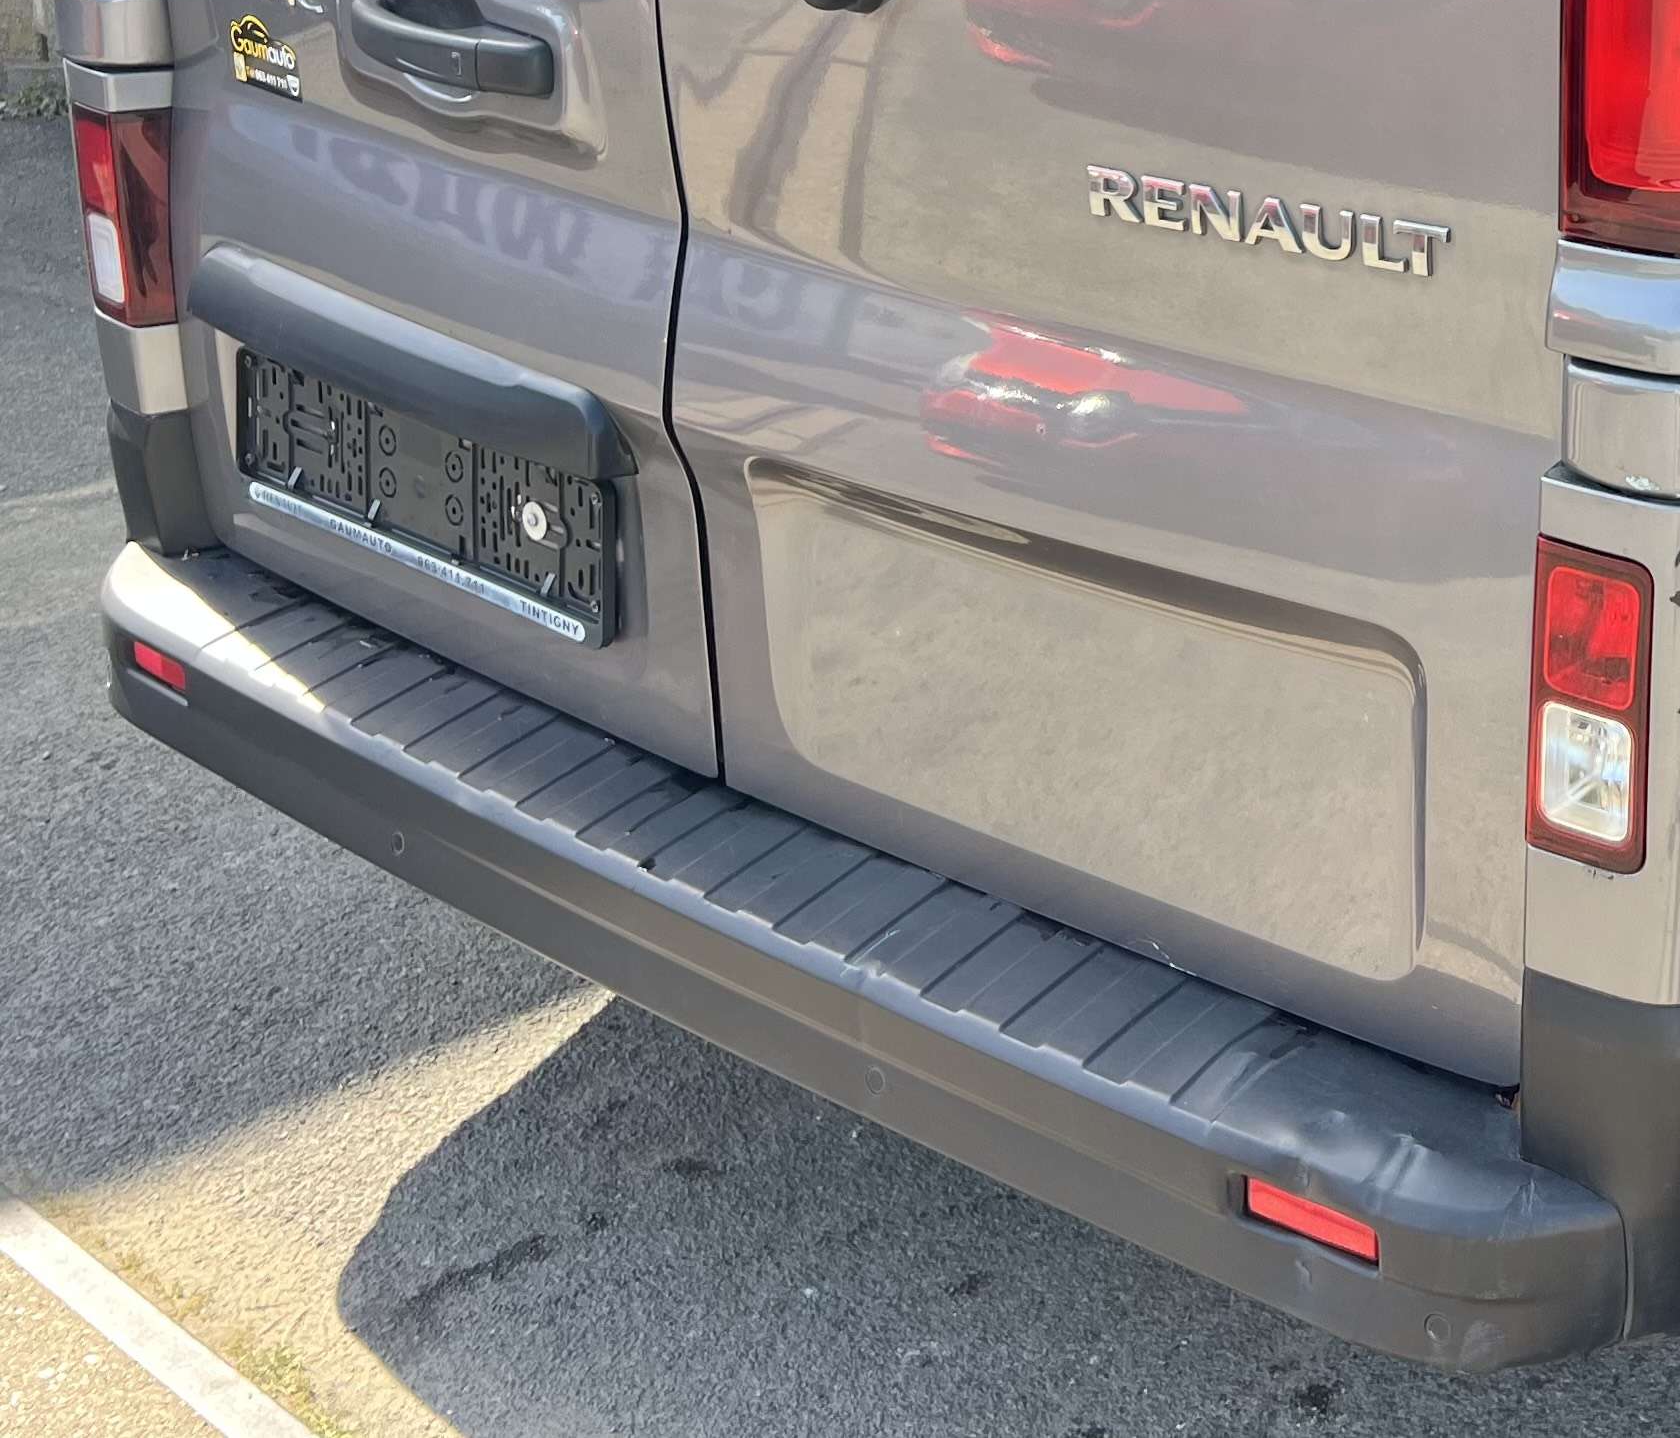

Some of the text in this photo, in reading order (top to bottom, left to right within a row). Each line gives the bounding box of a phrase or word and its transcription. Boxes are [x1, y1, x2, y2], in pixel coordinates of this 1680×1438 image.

[231, 25, 295, 70] Gaumauto
[1086, 164, 1452, 278] RENAULT
[329, 518, 393, 554] GAUMAUTO
[519, 599, 579, 636] TINTIGNY
